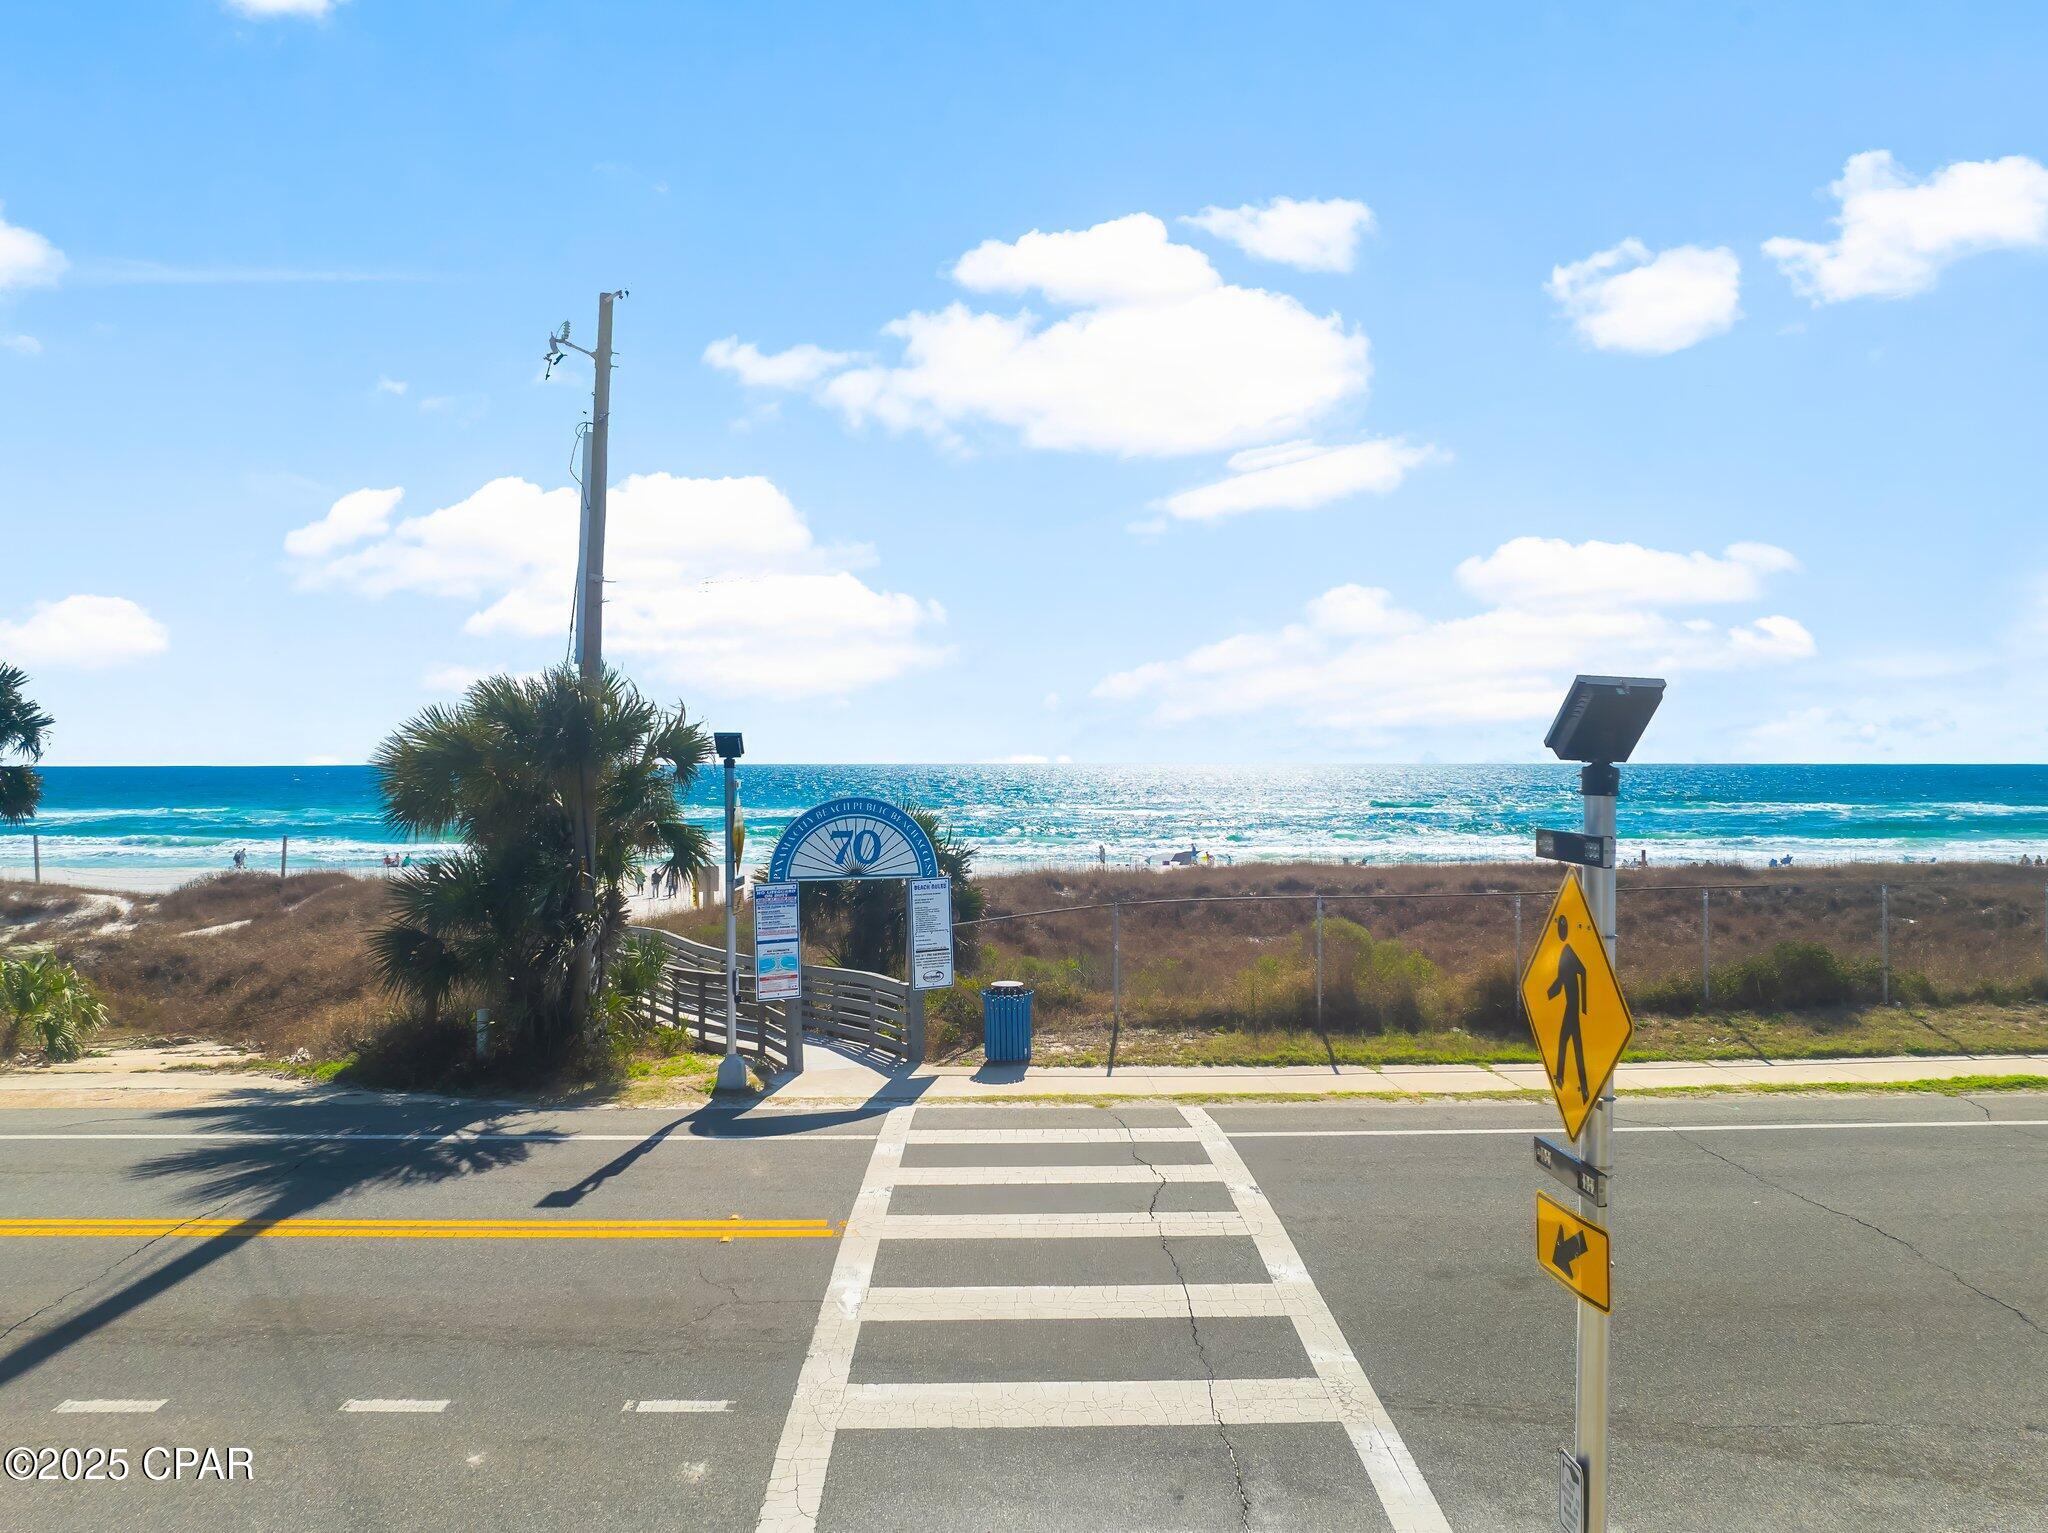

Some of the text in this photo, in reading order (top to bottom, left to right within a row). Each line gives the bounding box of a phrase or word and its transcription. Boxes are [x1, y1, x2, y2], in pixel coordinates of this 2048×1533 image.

[816, 802, 850, 819] BEACH
[853, 802, 888, 815] PUBLIC
[891, 811, 919, 839] BEACH
[916, 839, 933, 876] ACCESS
[830, 829, 882, 865] 70
